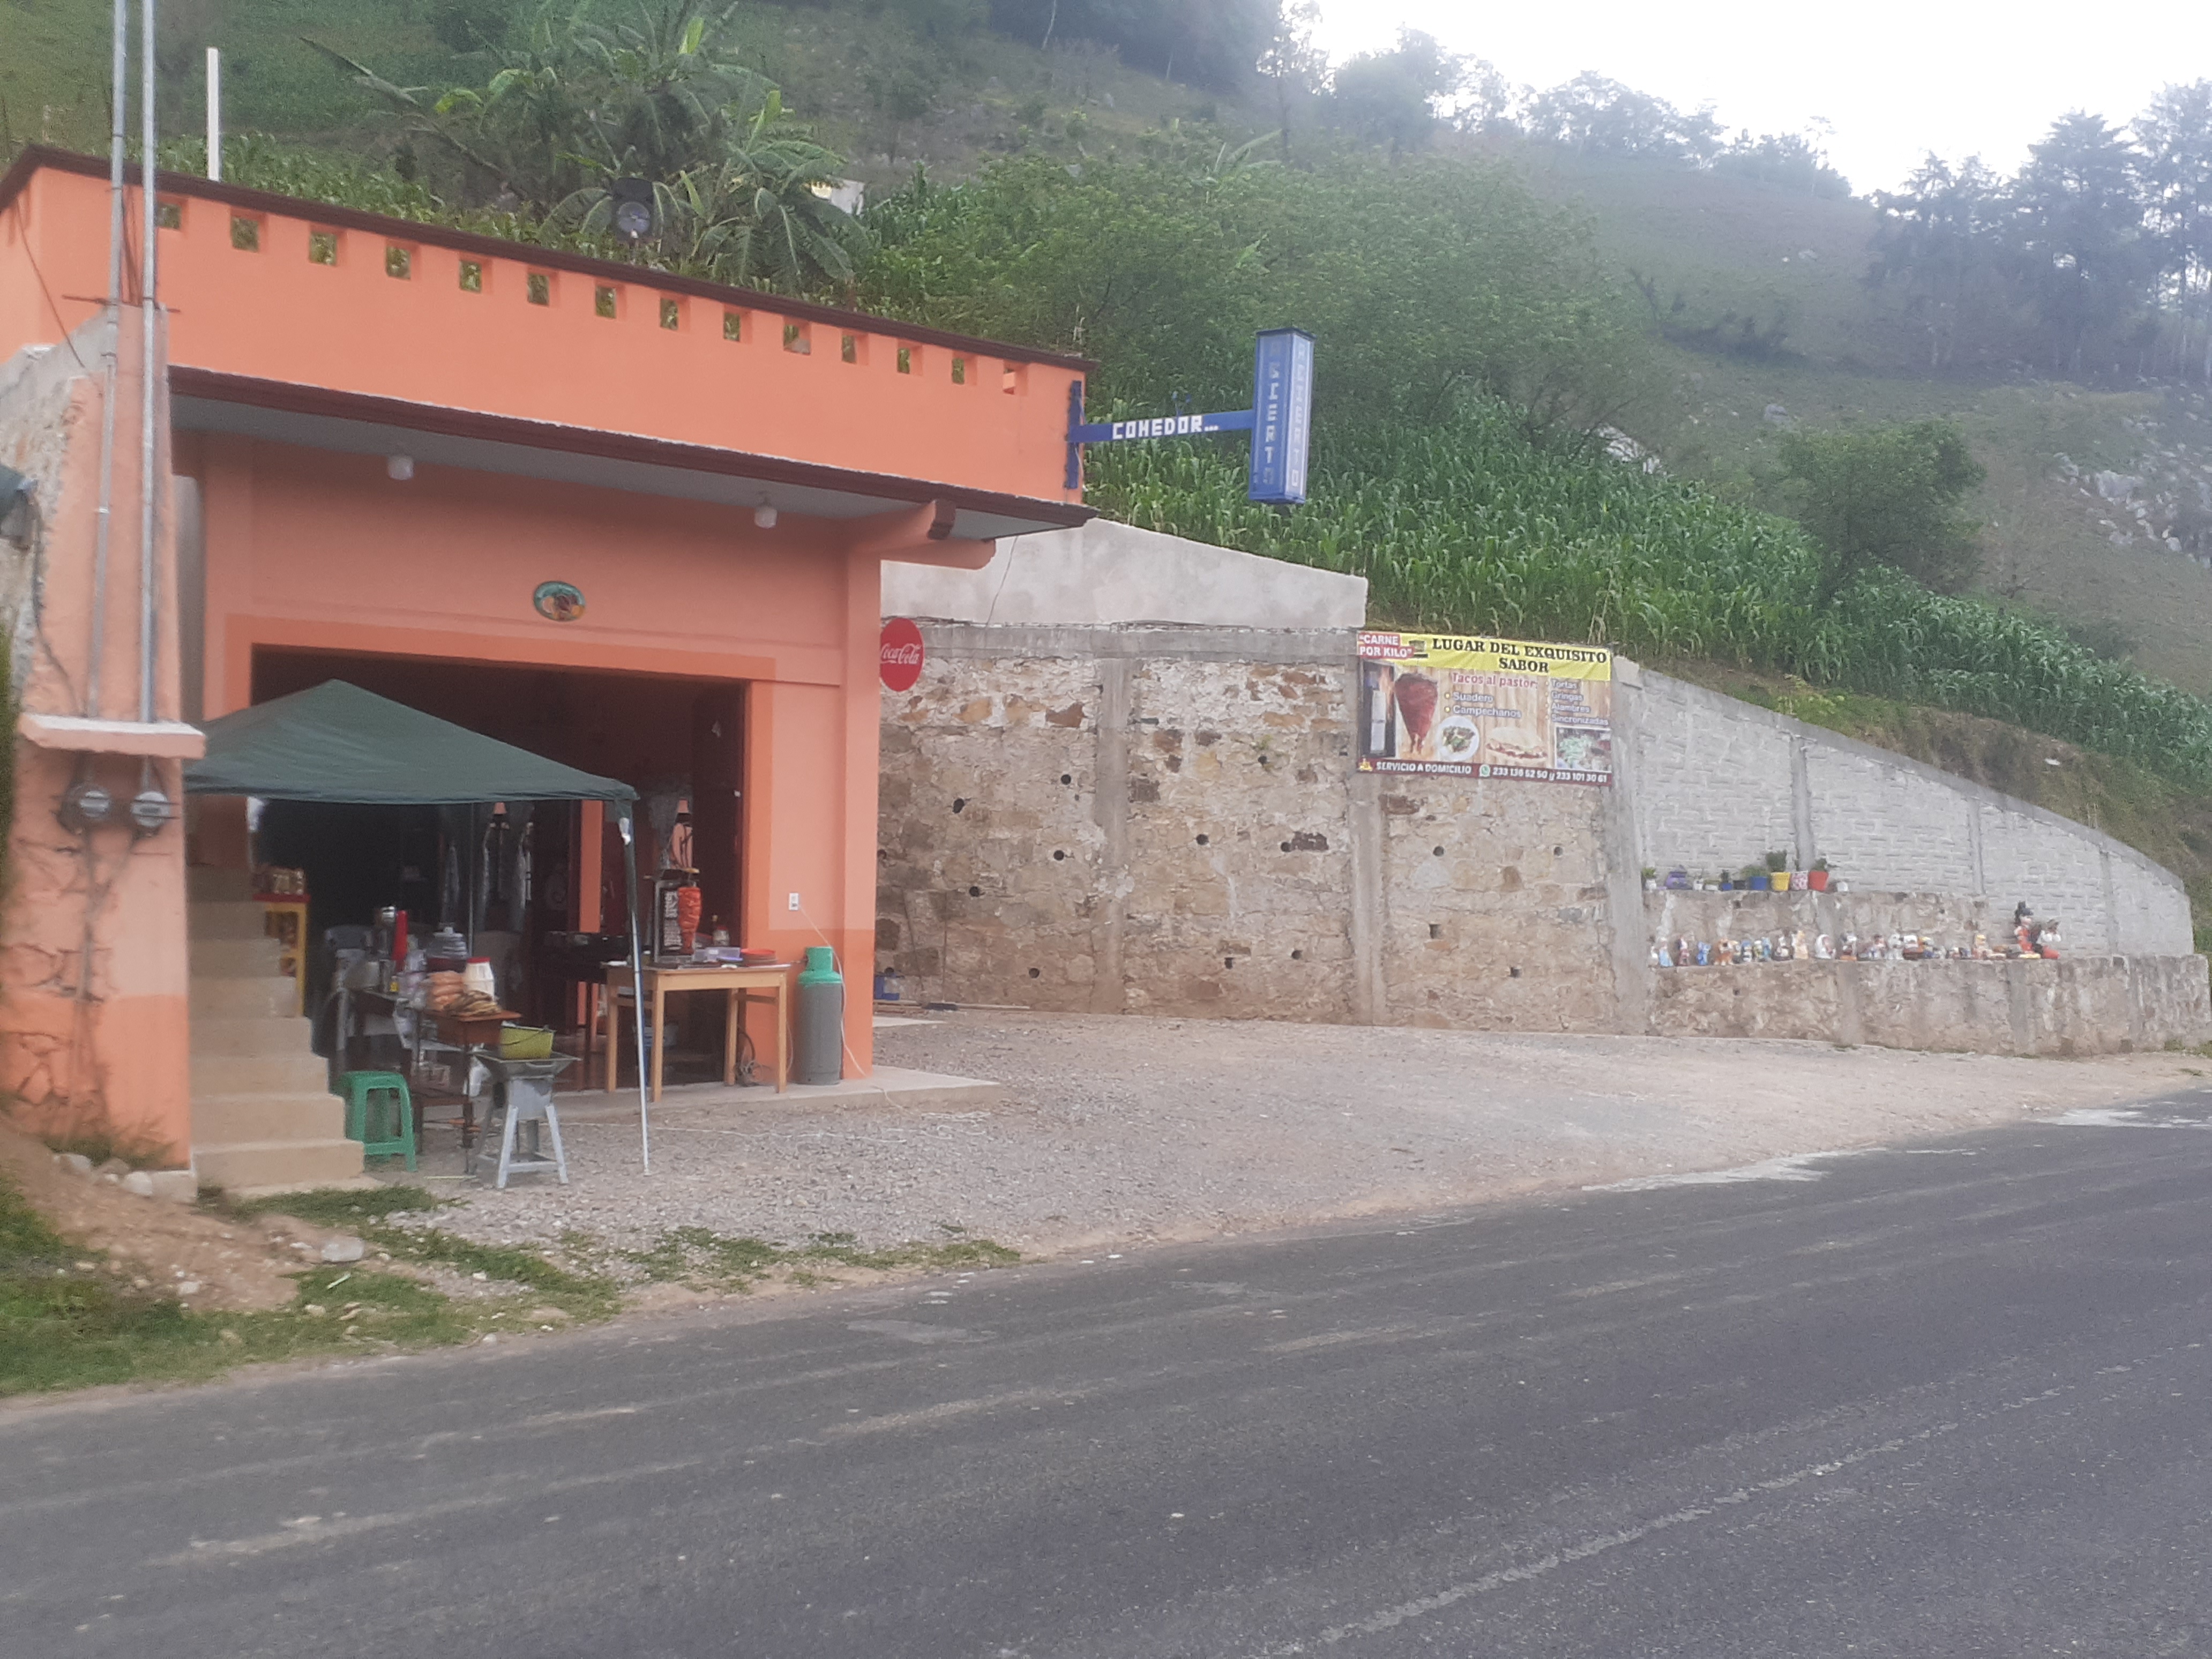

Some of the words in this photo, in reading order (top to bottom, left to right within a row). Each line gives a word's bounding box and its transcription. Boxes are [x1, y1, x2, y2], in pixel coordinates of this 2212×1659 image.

[1359, 646, 1381, 656] POR
[1432, 638, 1485, 652] LUGAR
[1490, 642, 1520, 655] DEL
[1524, 646, 1606, 663] EXQUISITO
[1499, 657, 1549, 673] SABOR
[1453, 672, 1483, 684] Tacos
[1486, 676, 1496, 685] al
[1552, 679, 1577, 689] Tortas
[1453, 692, 1493, 703] Suadero
[1551, 691, 1583, 702] Gringas
[1453, 705, 1521, 718] Campechanos
[1551, 703, 1590, 713] Alambres
[1551, 714, 1608, 725] Sincronizadas
[1376, 761, 1415, 772] SERVICIO
[1425, 764, 1471, 774] DOMICILIO
[1493, 767, 1508, 776] 233
[1556, 772, 1571, 780] 233
[1586, 774, 1596, 782] 30
